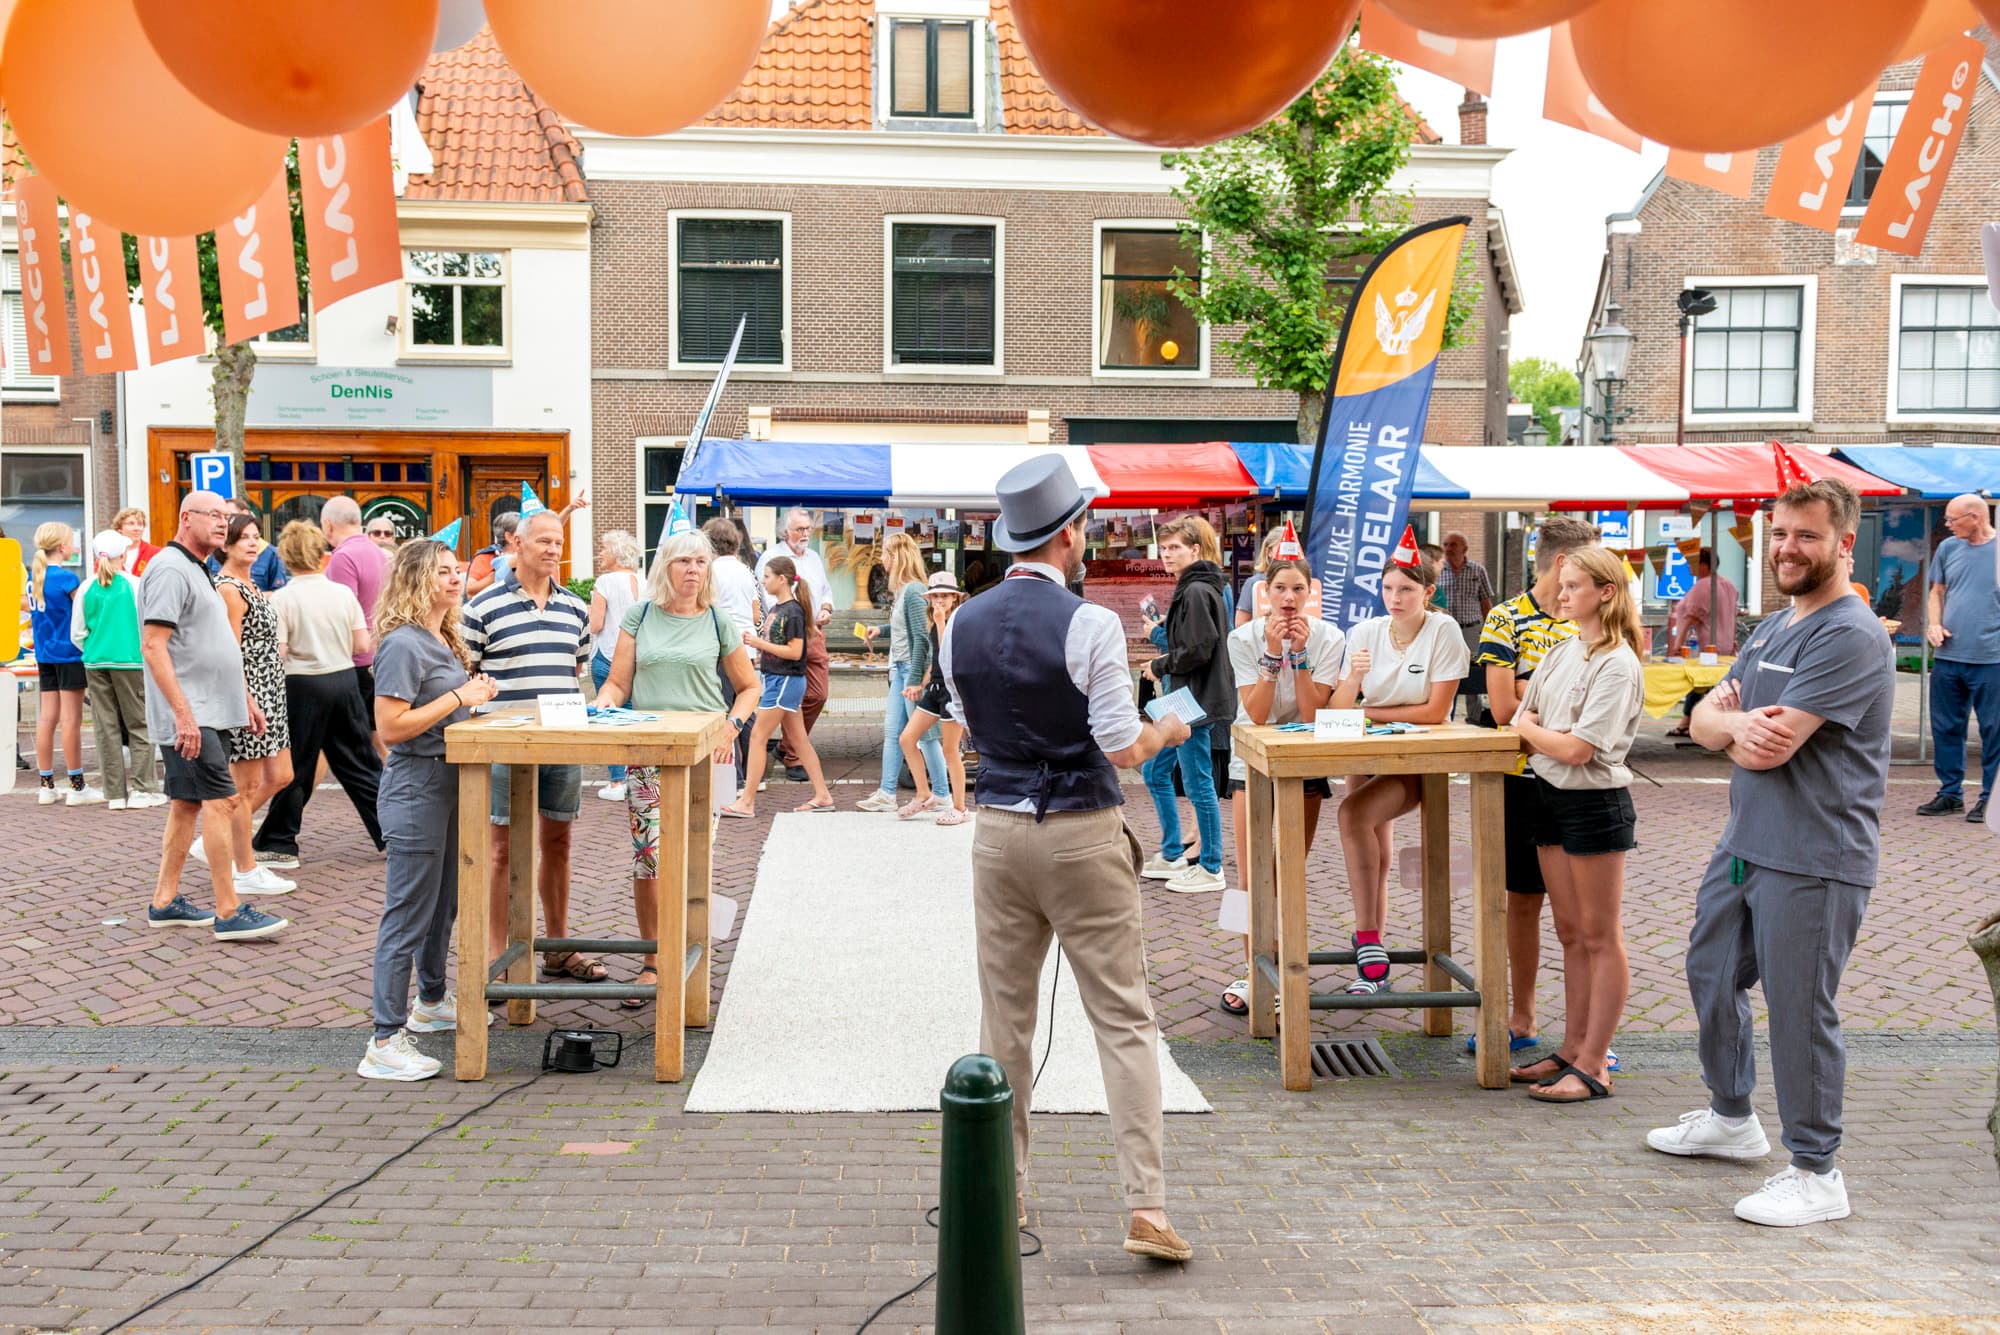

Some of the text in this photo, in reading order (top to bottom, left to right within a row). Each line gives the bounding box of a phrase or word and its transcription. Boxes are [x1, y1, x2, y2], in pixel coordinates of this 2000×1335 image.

[310, 368, 414, 385] Schoen & Sleutelservice
[331, 383, 393, 399] DenNis
[201, 459, 225, 490] P
[1335, 421, 1372, 518] HARMONIE
[1353, 424, 1410, 597] ADELAAR
